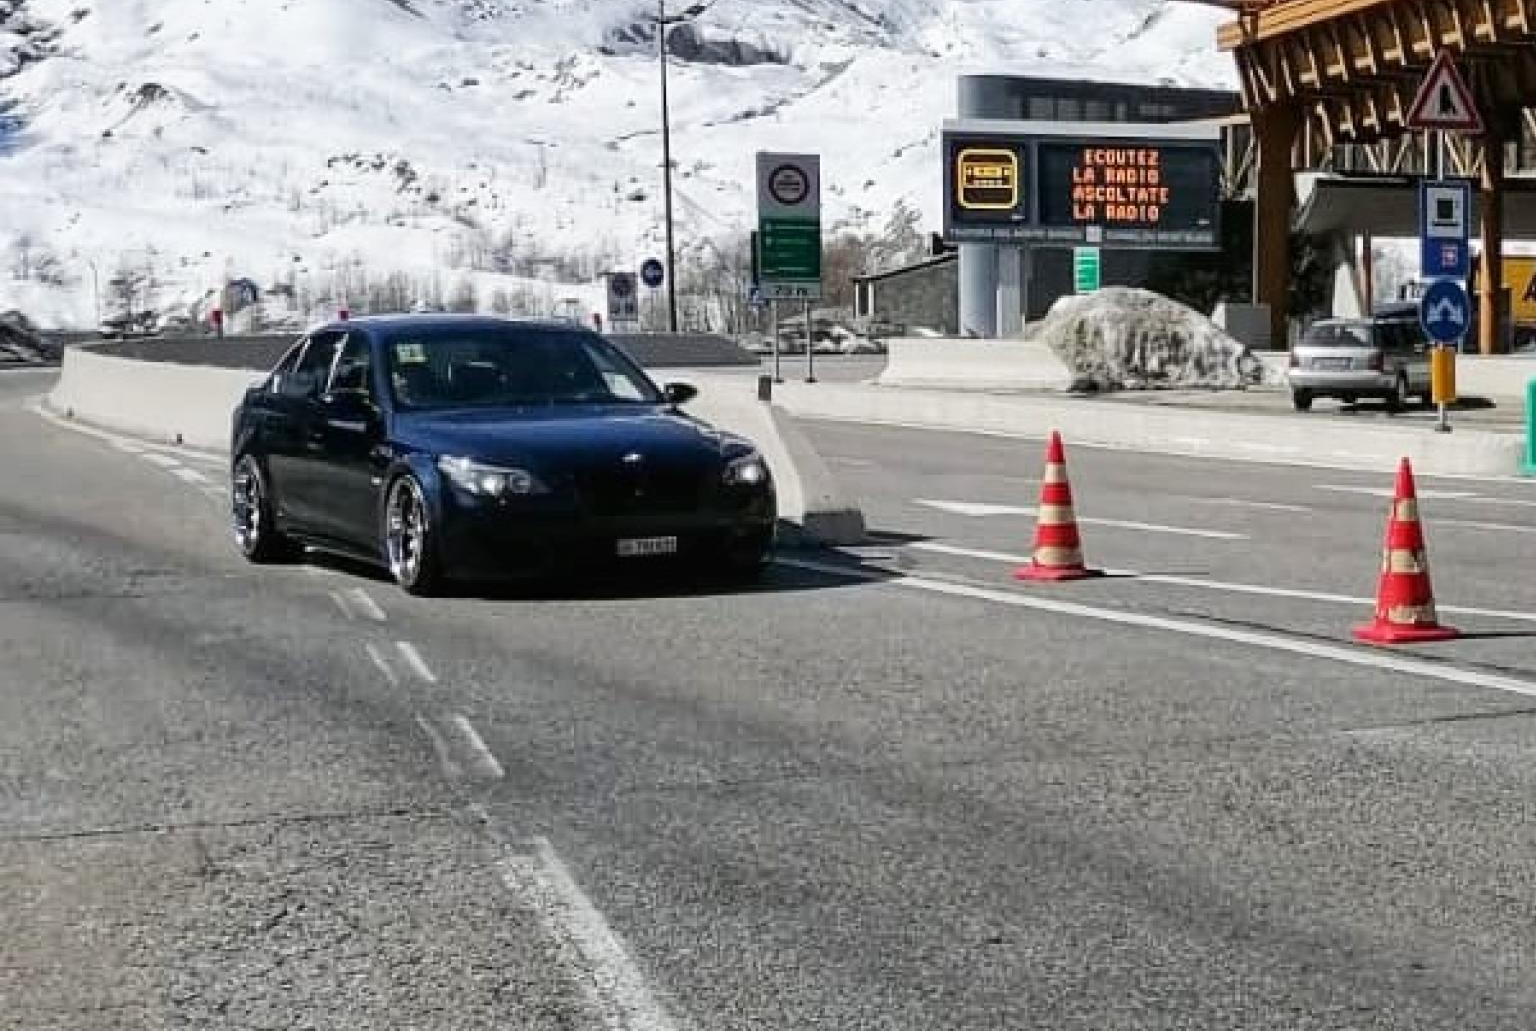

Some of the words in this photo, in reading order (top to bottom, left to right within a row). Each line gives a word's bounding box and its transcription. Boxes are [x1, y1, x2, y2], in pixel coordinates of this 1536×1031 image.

[1084, 148, 1159, 166] ECOUTEZ
[1072, 167, 1095, 183] LA
[1105, 167, 1159, 184] RADIO
[1072, 185, 1169, 204] ASCOLTATE
[1072, 203, 1095, 221] LA
[1105, 204, 1159, 222] RADIO
